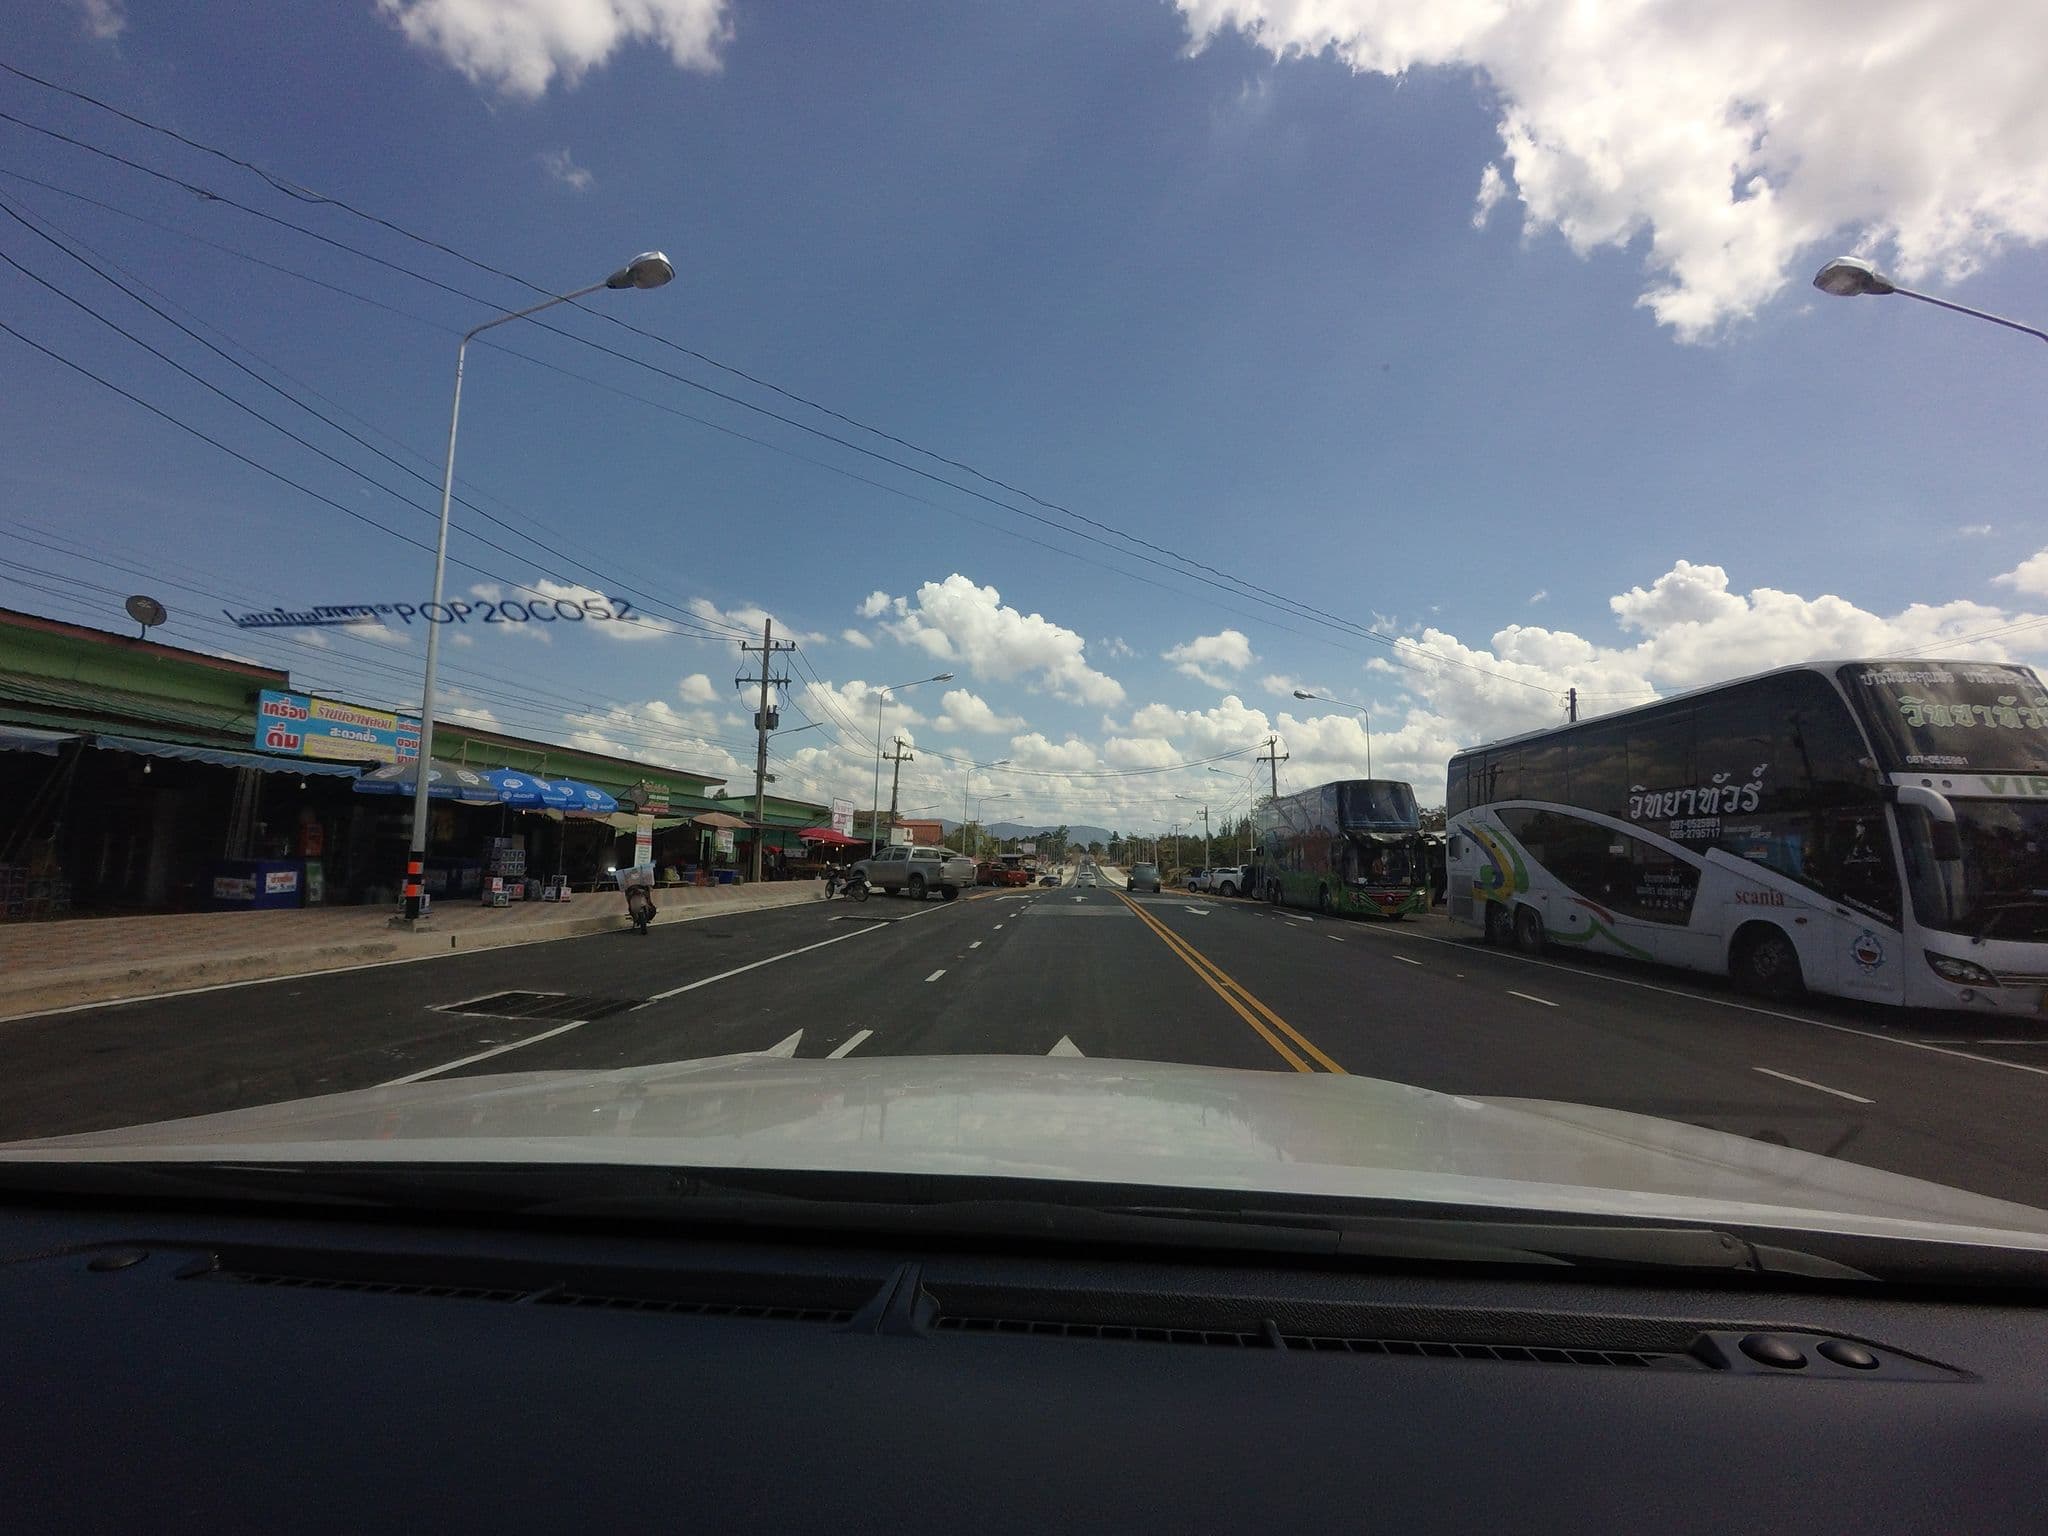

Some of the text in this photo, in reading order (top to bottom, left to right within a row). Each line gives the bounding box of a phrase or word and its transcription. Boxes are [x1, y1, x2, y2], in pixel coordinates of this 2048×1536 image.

[262, 696, 309, 721] เครื่อง
[265, 722, 301, 749] ดื่ม
[1628, 763, 1769, 820] วิทยาทัวร์
[1735, 888, 1785, 907] scania
